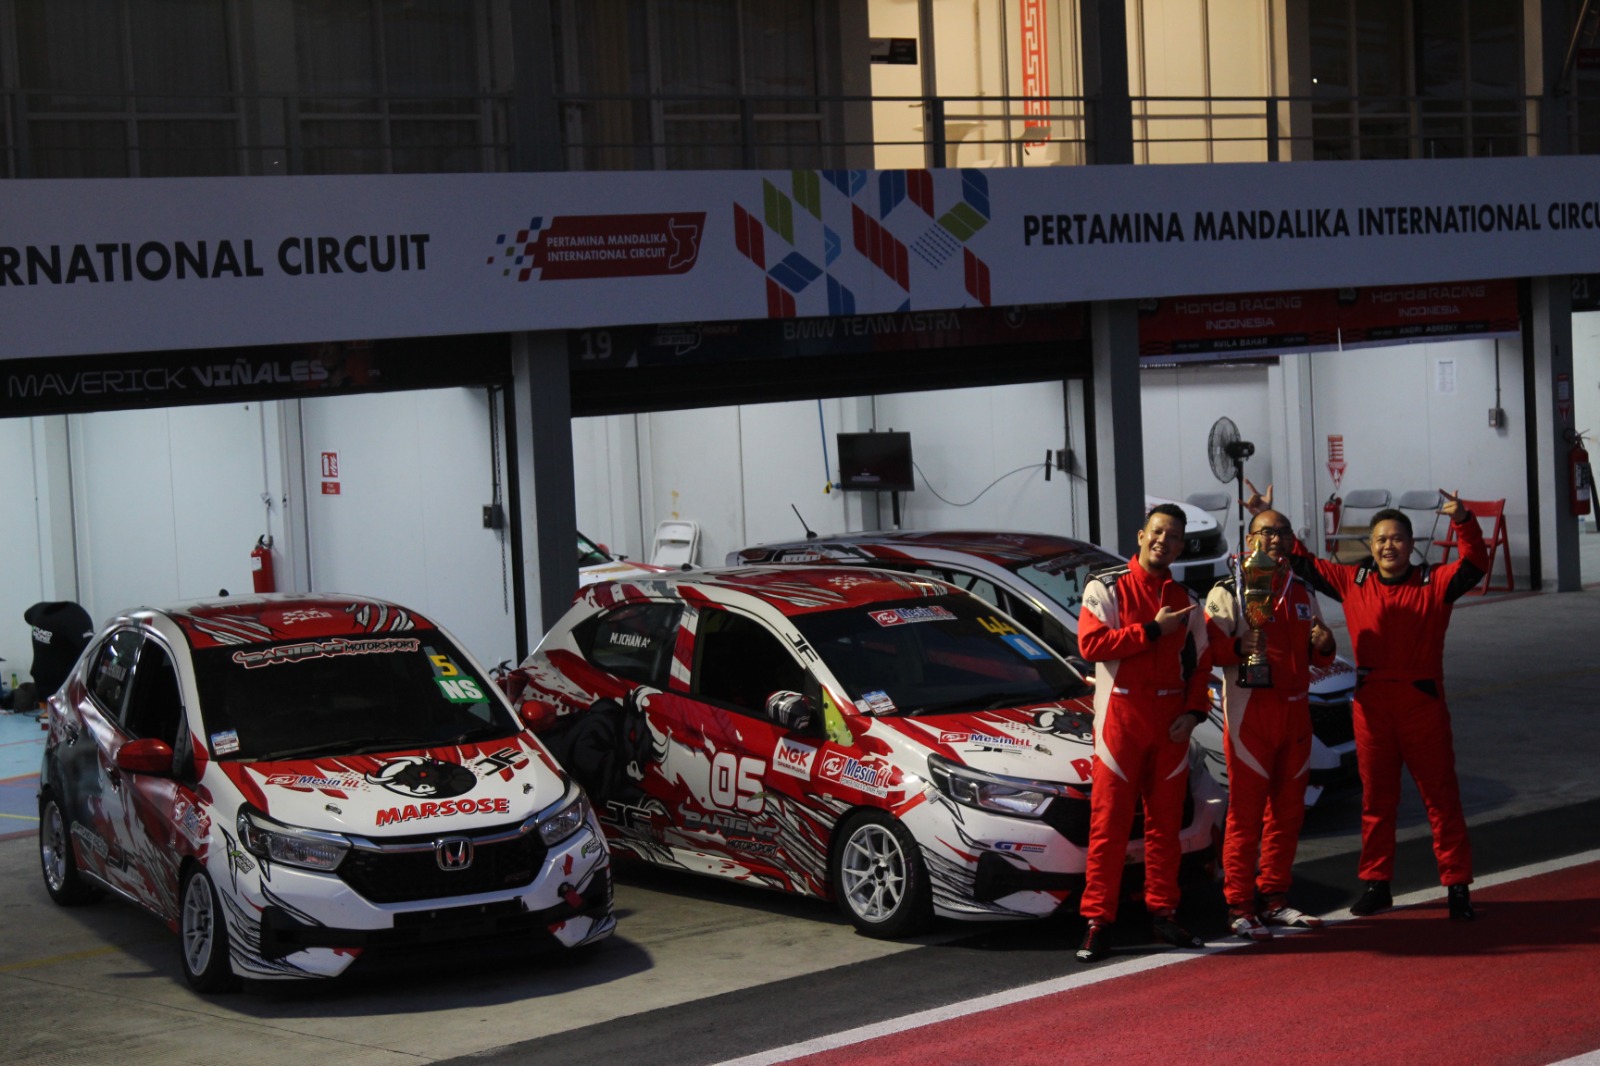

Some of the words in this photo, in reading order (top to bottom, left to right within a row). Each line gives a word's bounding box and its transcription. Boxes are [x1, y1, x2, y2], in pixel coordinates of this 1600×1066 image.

[1024, 212, 1184, 246] PERTAMINA
[1193, 208, 1350, 241] MANDALIKA
[1358, 203, 1541, 236] INTERNATIONAL
[546, 235, 605, 248] PERTAMINA
[607, 233, 668, 245] MANDALIKA
[0, 239, 264, 286] RNATIONAL
[278, 234, 430, 276] CIRCUIT
[547, 249, 628, 262] INTERNATIONAL
[630, 248, 666, 260] CIRCUIT
[1372, 289, 1427, 303] Honda
[1429, 285, 1486, 299] RACING
[1573, 278, 1590, 300] 21
[1174, 299, 1237, 314] Honda
[1239, 296, 1302, 310] RACING
[1399, 305, 1460, 318] INDONESIA
[783, 319, 835, 341] BMW
[842, 314, 897, 335] TEAM
[902, 311, 960, 332] ASTRA
[1206, 317, 1275, 330] INDONESIA
[581, 331, 612, 360] 19
[7, 367, 187, 399] MAVERICK
[191, 357, 329, 389] VIÑALES
[894, 606, 935, 619] Mesin
[344, 640, 417, 653] MOTORSPORT
[430, 655, 458, 677] 5
[439, 680, 484, 699] NS
[970, 734, 1013, 745] Mesin
[1013, 738, 1033, 747] HL
[778, 745, 810, 767] NGK
[298, 775, 341, 787] Mesin
[342, 780, 359, 788] HL
[712, 752, 766, 812] 05
[844, 757, 877, 785] Mesin
[875, 765, 893, 789] HL
[375, 798, 510, 827] MARSOSE
[677, 802, 782, 841] BANTENG
[727, 837, 778, 858] MOTORSPORT
[995, 841, 1030, 851] GT
